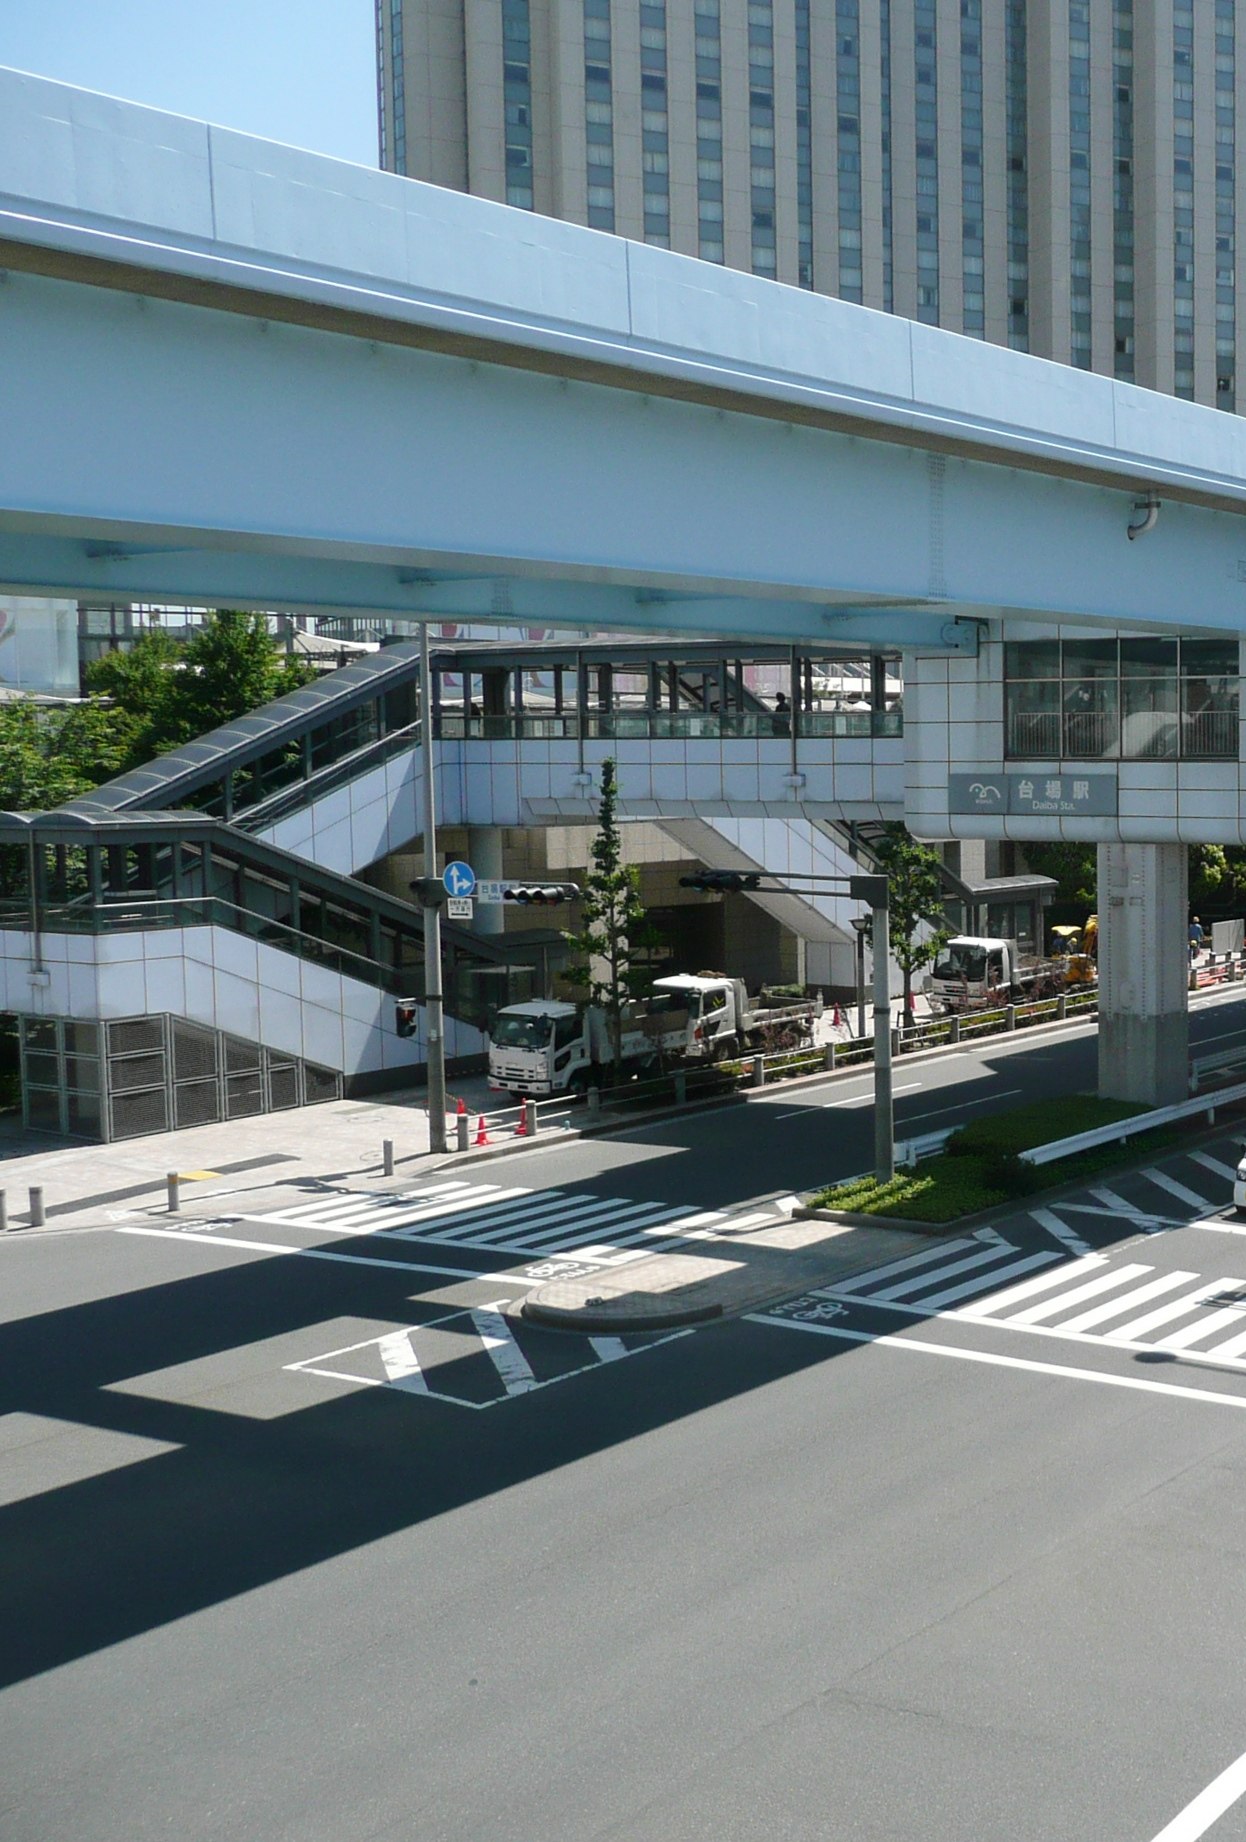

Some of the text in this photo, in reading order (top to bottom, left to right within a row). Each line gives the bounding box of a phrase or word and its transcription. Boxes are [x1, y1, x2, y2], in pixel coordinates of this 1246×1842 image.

[1017, 780, 1089, 800] 台場駅
[1032, 800, 1058, 810] Daiba
